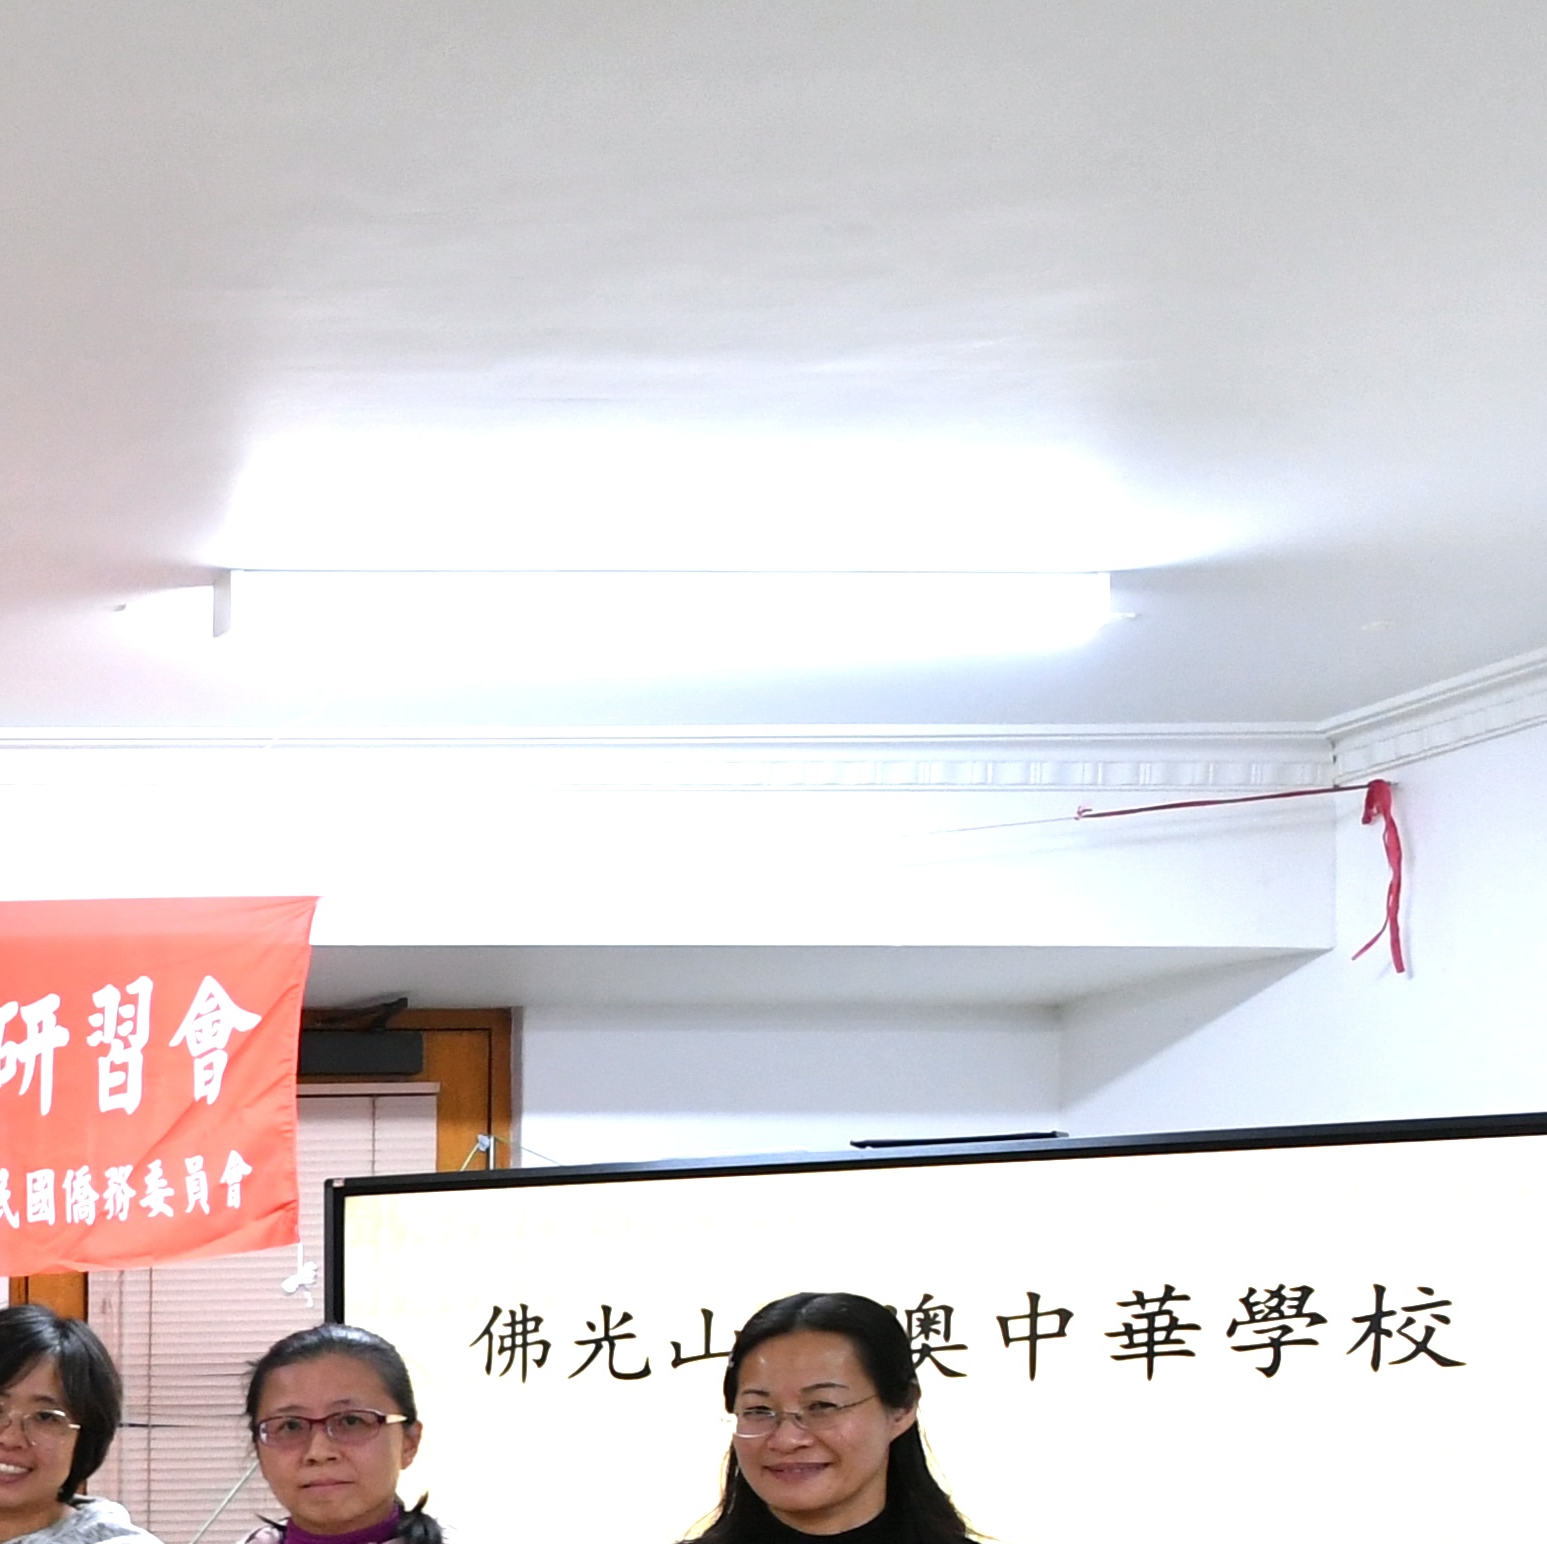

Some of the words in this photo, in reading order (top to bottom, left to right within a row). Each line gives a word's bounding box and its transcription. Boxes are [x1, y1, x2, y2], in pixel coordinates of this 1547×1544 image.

[470, 1284, 1466, 1383] 佛光山澳中華學校
